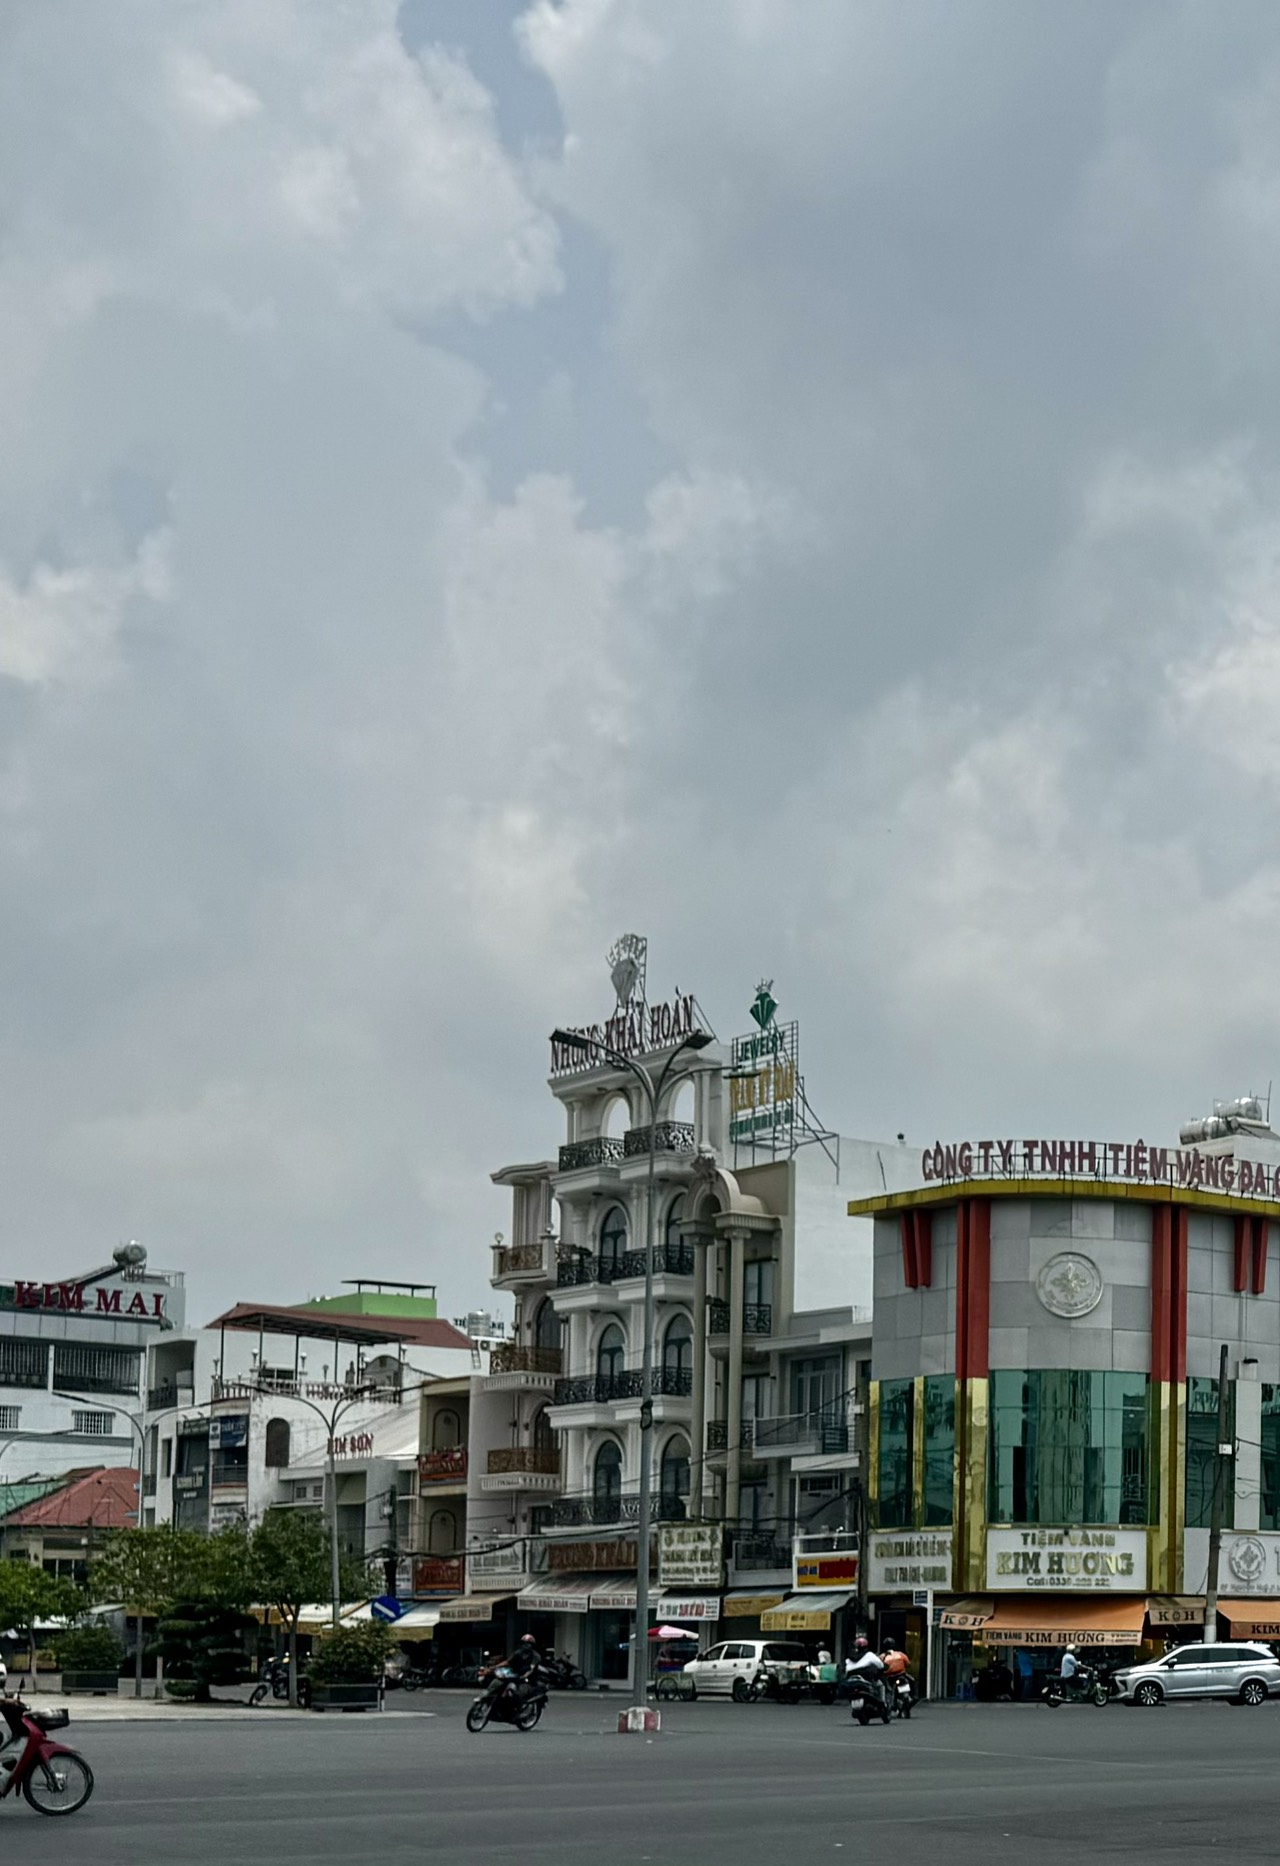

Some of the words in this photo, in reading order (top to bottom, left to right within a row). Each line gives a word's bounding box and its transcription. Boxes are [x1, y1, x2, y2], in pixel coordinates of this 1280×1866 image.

[922, 1140, 973, 1181] CÔNG
[979, 1140, 1013, 1173] TY
[1023, 1140, 1097, 1173] TNHH
[1176, 1147, 1235, 1189] VÀNG
[15, 1281, 86, 1311] KIM
[95, 1288, 164, 1316] MAI
[997, 1551, 1041, 1575] KIM
[1047, 1551, 1134, 1576] HƯƠNG
[1159, 1611, 1169, 1621] K
[1184, 1611, 1194, 1620] H
[1025, 1632, 1052, 1643] KIM
[1057, 1631, 1105, 1643] HƯƠNG
[1251, 1624, 1280, 1635] KIM
